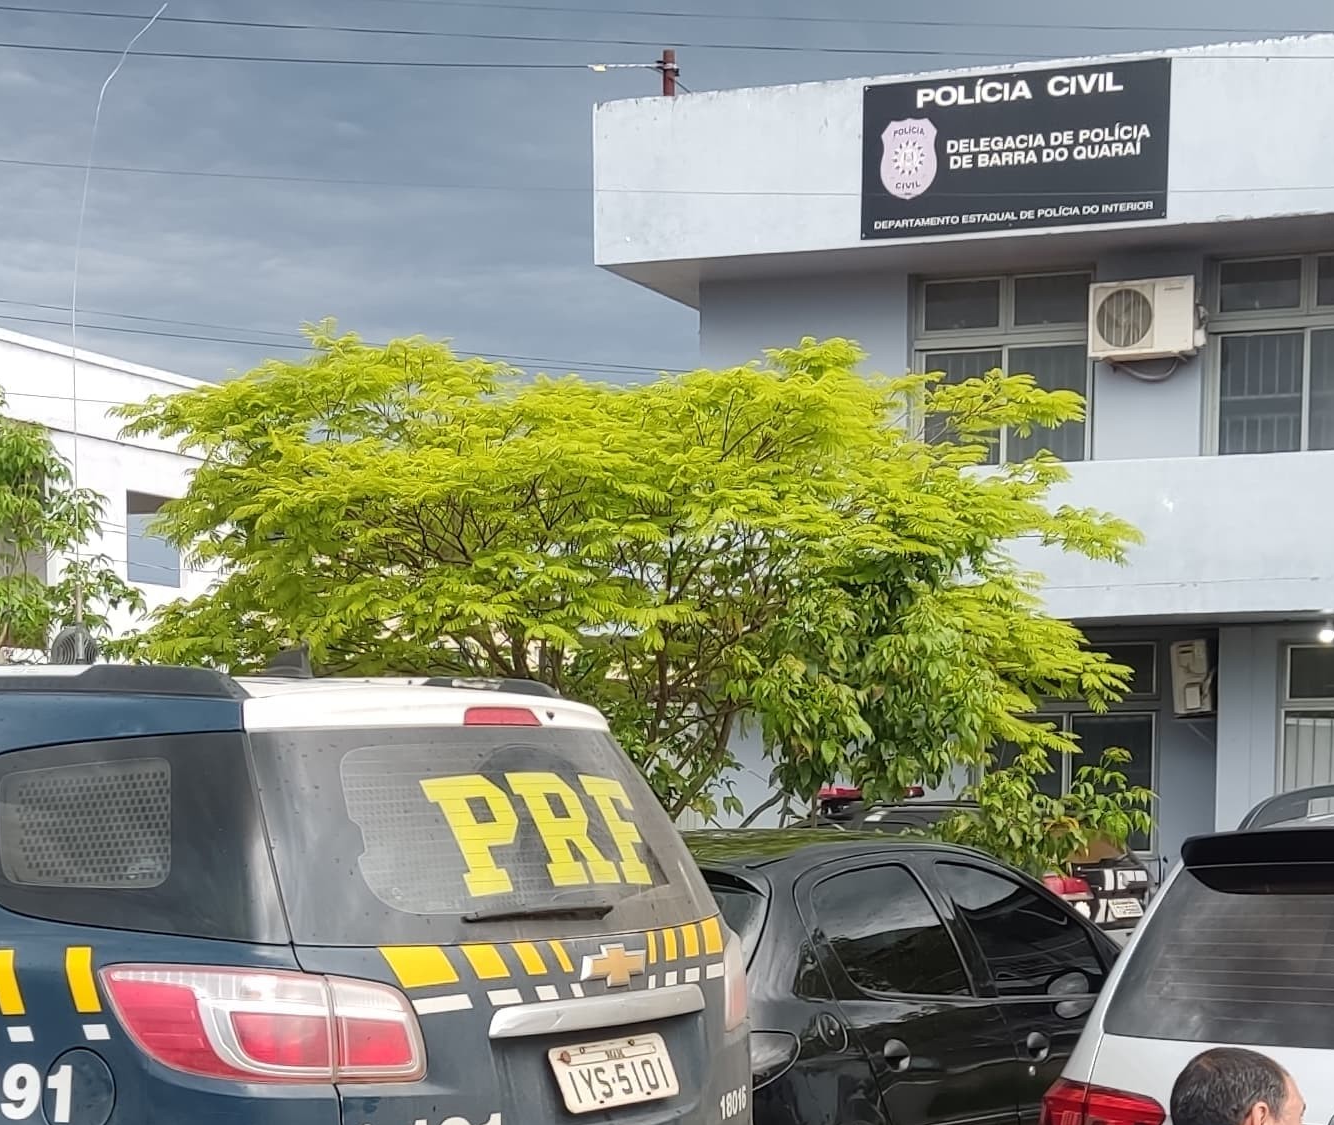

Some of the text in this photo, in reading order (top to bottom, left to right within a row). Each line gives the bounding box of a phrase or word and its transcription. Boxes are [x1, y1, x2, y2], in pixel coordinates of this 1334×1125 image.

[916, 71, 1125, 109] POLÍCIA CIVIL
[946, 122, 1152, 155] DELEGACIA DE POLÍCIA
[949, 138, 1142, 170] DE BARRA DO QUARAÍ
[895, 181, 921, 191] CIVIL
[873, 200, 1154, 230] DEPARTAMENTO ESTADUAL DE POLÍCIA DO INTERIOR
[419, 771, 653, 897] PRF
[720, 1085, 747, 1120] 18016
